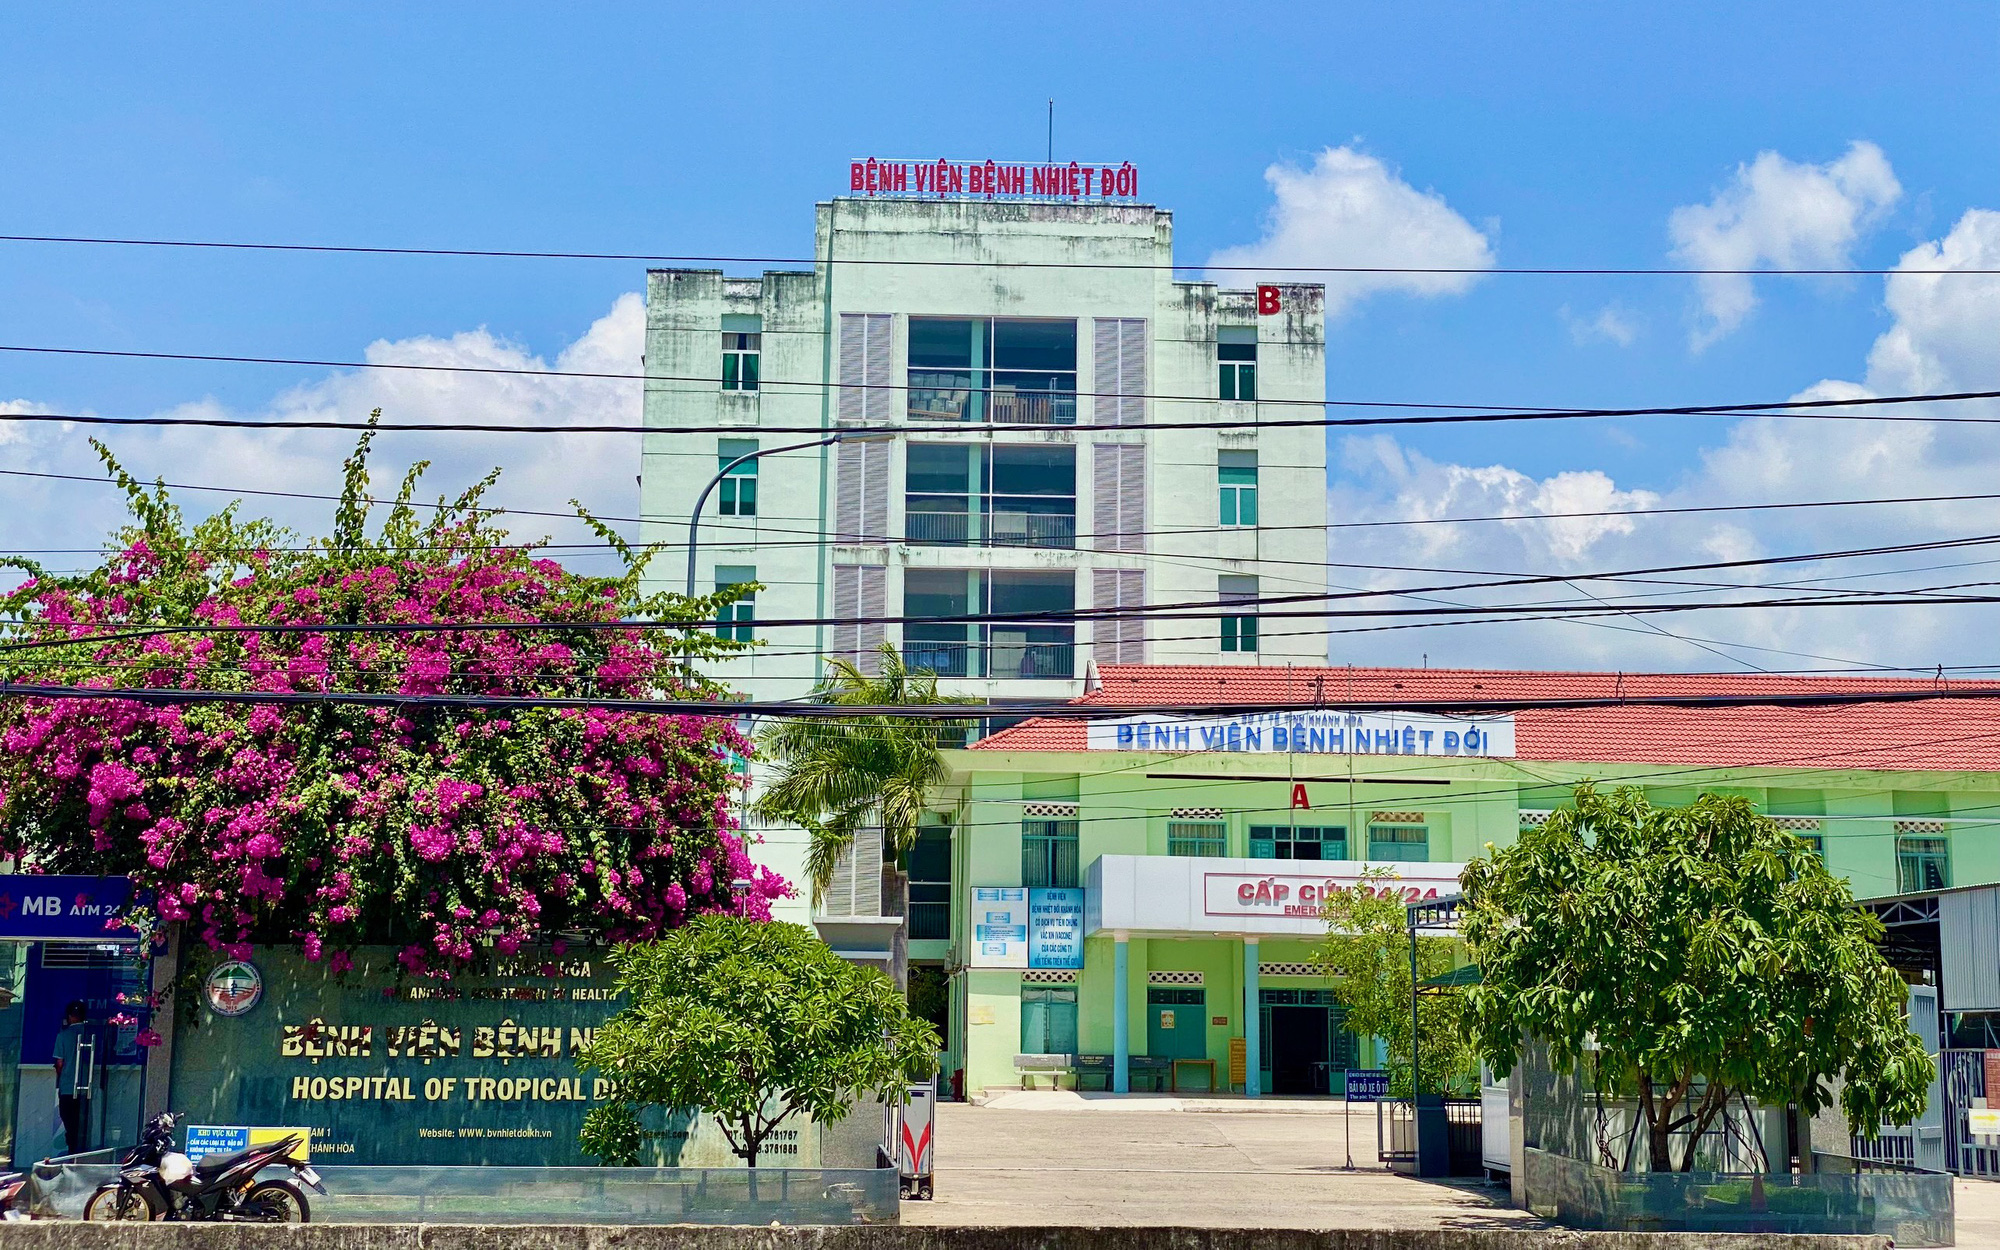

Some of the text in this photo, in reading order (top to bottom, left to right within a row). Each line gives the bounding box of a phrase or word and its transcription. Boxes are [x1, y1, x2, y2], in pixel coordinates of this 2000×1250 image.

[850, 156, 1138, 202] BỆNH VIỆN BỆNH NHIỆT ĐỚI
[1257, 285, 1282, 316] B
[1308, 713, 1341, 728] KHÁNH
[1117, 721, 1488, 757] BỆNH VIỆN BỆNH NHIỆT ĐỚI
[1292, 784, 1310, 810] A
[1237, 877, 1290, 906] CẤP
[22, 896, 62, 916] MB
[571, 987, 618, 1000] HEALTH
[282, 1018, 373, 1065] BỆNH
[387, 1018, 461, 1065] VIỆN
[473, 1018, 562, 1065] BỆNH
[292, 1076, 417, 1101] HOSPITAL
[424, 1076, 456, 1101] OF
[464, 1077, 587, 1101] TROPICAL
[1368, 1082, 1376, 1093] XE
[310, 1127, 325, 1137] AM
[419, 1127, 456, 1138] Website:
[487, 1127, 552, 1138] bvnhietdoikh.vn
[338, 1141, 355, 1154] HÒA
